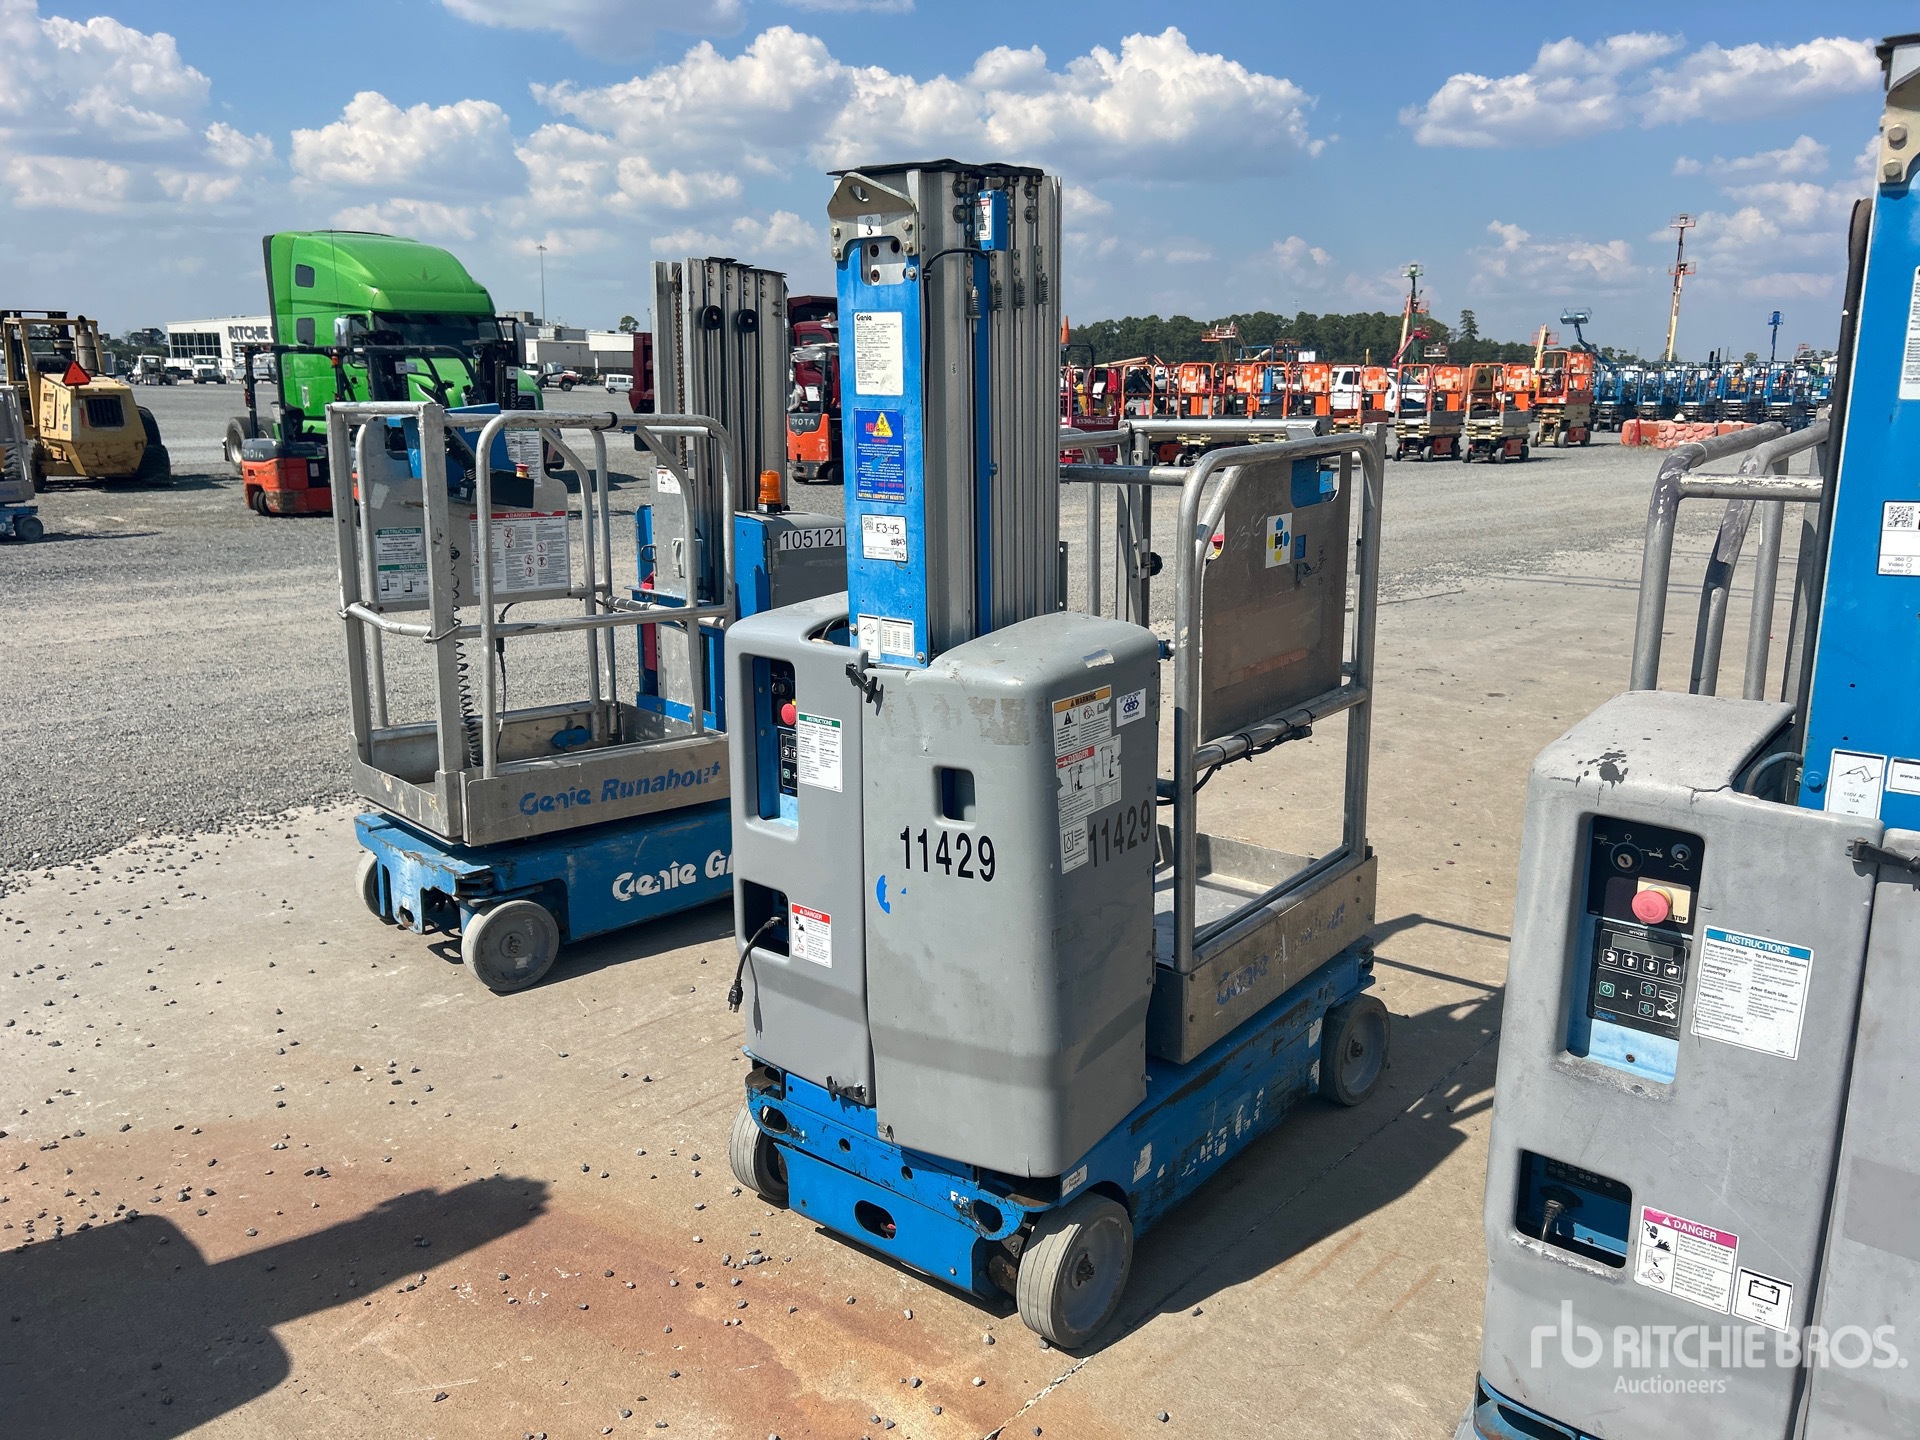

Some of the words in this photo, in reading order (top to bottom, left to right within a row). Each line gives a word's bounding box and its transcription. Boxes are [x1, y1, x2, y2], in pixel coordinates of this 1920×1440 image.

[228, 326, 269, 341] RITCHIE
[790, 418, 816, 426] TOYOTA
[782, 528, 842, 549] 105121
[1075, 692, 1096, 705] WARNING
[806, 716, 833, 726] INSTRUCTIONS
[519, 785, 592, 816] Genie
[1089, 799, 1151, 867] 11429
[900, 825, 996, 882] 11429
[612, 860, 697, 902] Genie
[803, 909, 823, 921] DANGER
[1671, 914, 1687, 923] STOP
[1707, 942, 1734, 952] Emergency
[1725, 934, 1790, 955] INSTRUCTIONS
[1704, 962, 1731, 973] Emergency
[1785, 959, 1806, 968] Platform
[1700, 992, 1724, 1001] Operation
[1673, 1220, 1717, 1241] DANGER
